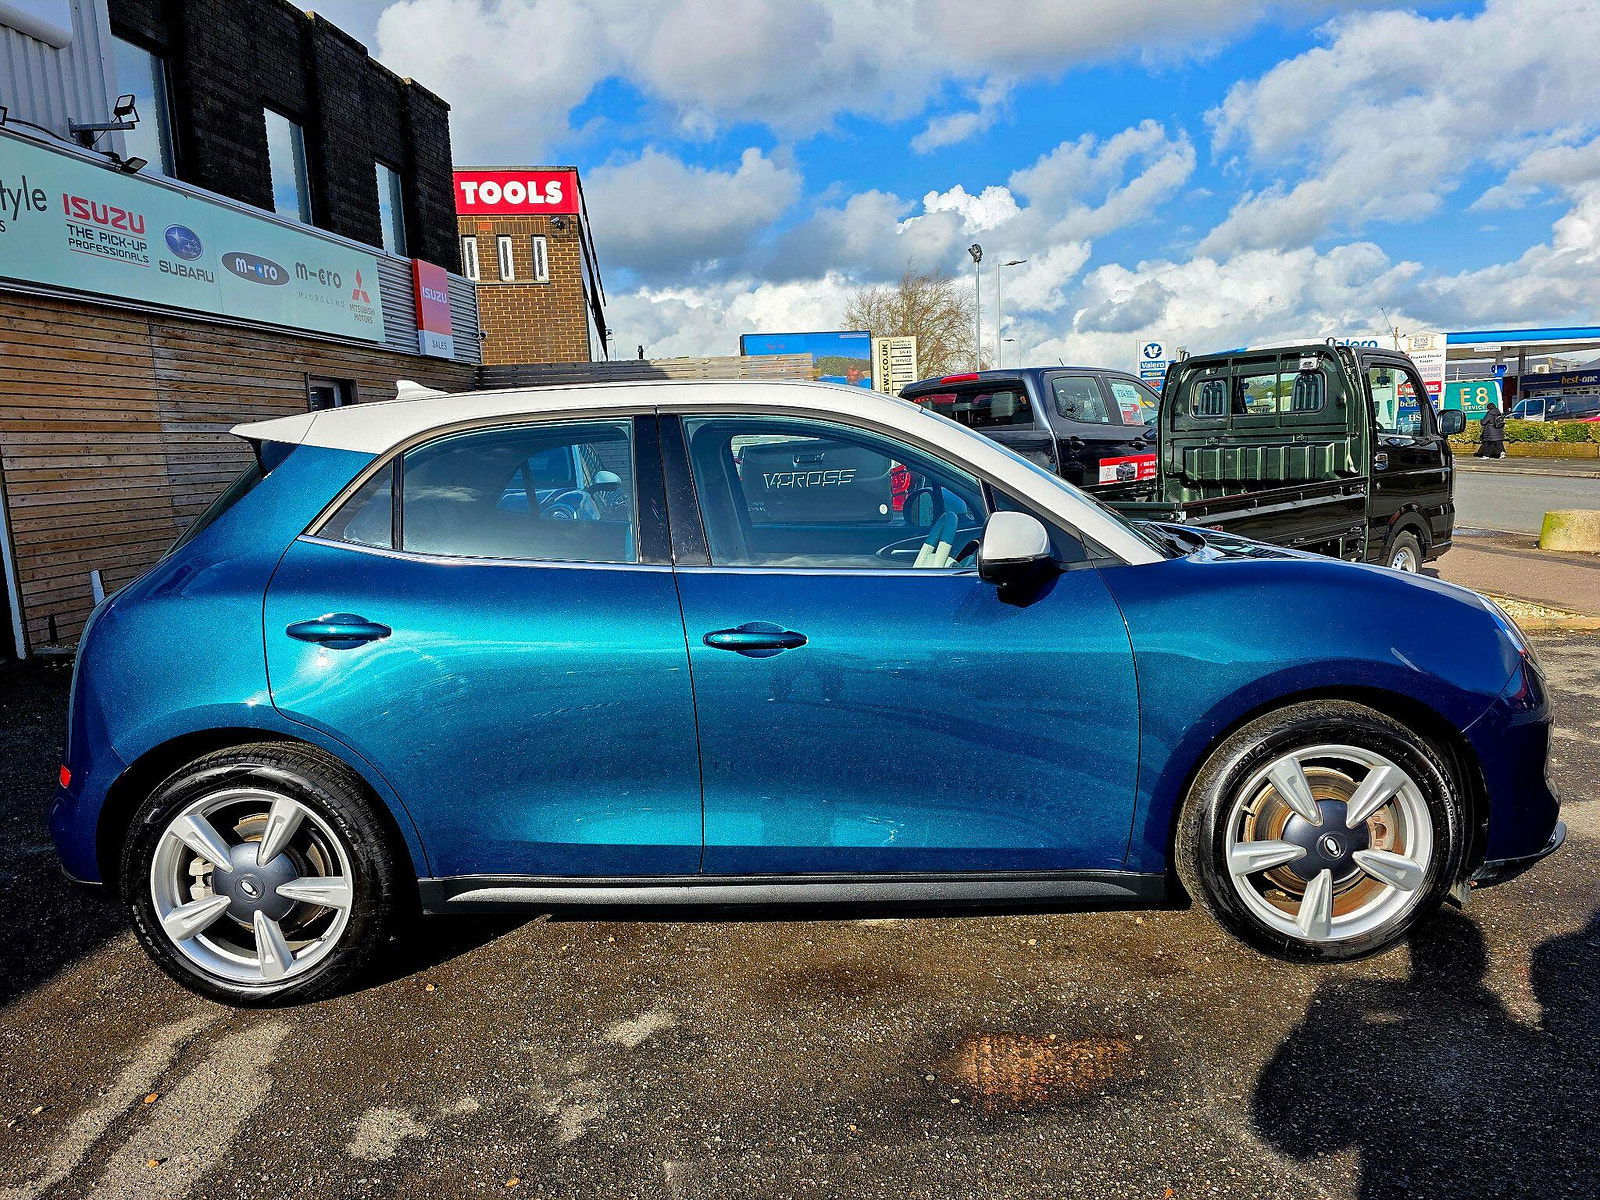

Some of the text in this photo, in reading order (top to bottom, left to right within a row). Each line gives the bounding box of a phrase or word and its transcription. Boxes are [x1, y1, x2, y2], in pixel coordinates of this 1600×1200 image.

[460, 181, 563, 204] TOOLS
[63, 193, 145, 234] ISUZU
[67, 224, 147, 252] THE PICK-UP
[68, 238, 149, 263] PROFESSIONALS
[159, 260, 214, 283] SUBARU
[422, 287, 447, 304] ISUZU
[432, 339, 448, 351] SALES
[1141, 361, 1165, 369] Valero
